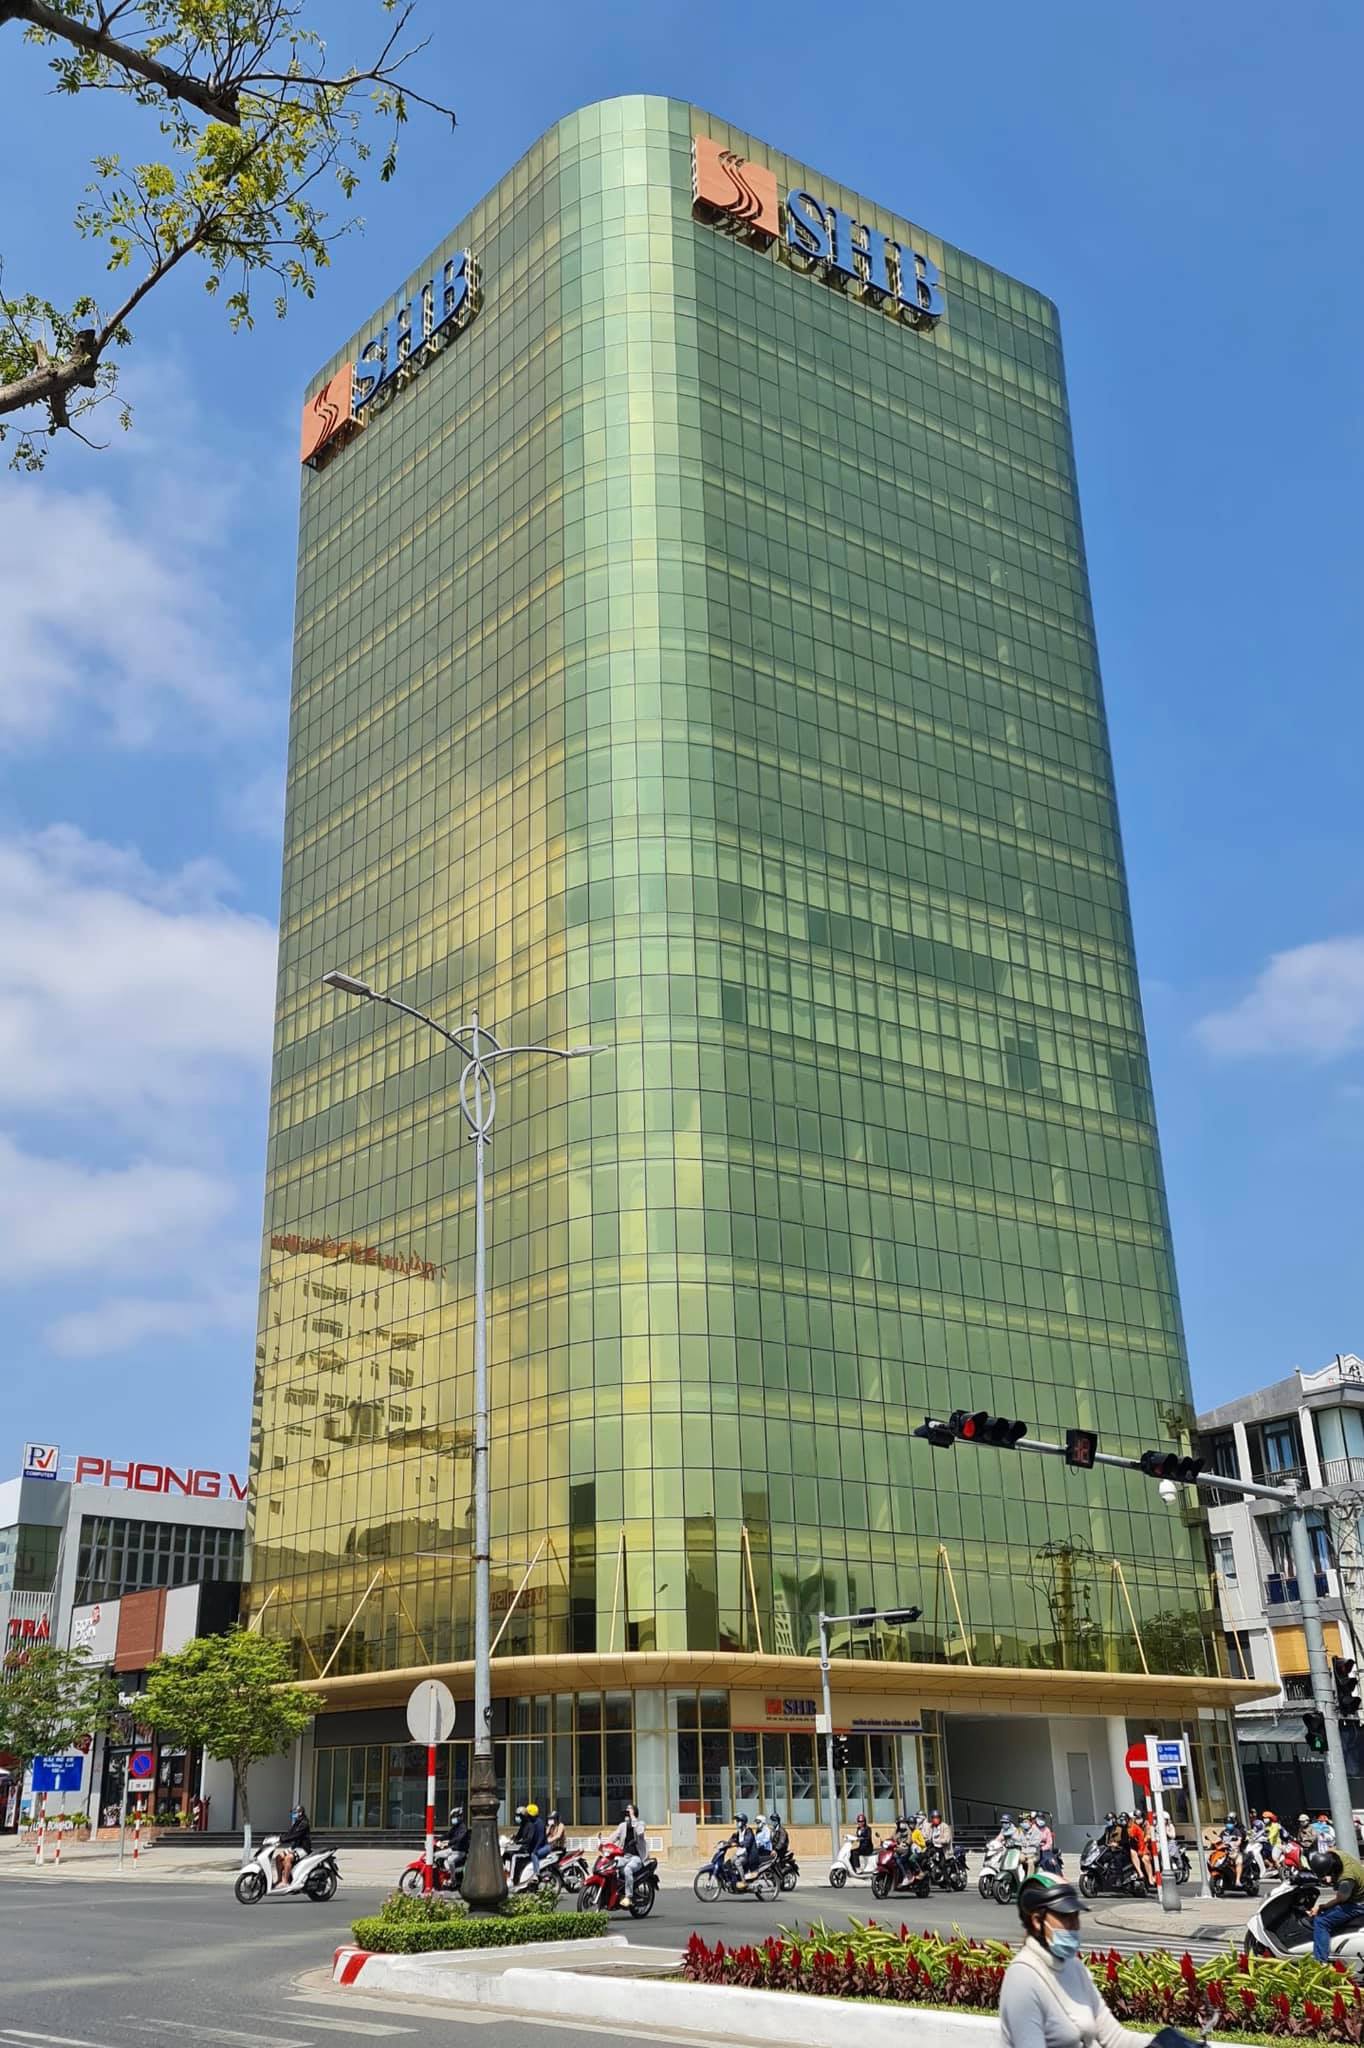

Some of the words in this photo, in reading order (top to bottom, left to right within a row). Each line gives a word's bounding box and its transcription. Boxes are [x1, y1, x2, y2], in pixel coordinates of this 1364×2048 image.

[785, 187, 945, 319] SHB
[352, 248, 475, 412] SHB
[75, 1455, 222, 1498] PHONG
[228, 1473, 248, 1500] V
[783, 1698, 816, 1715] SHB
